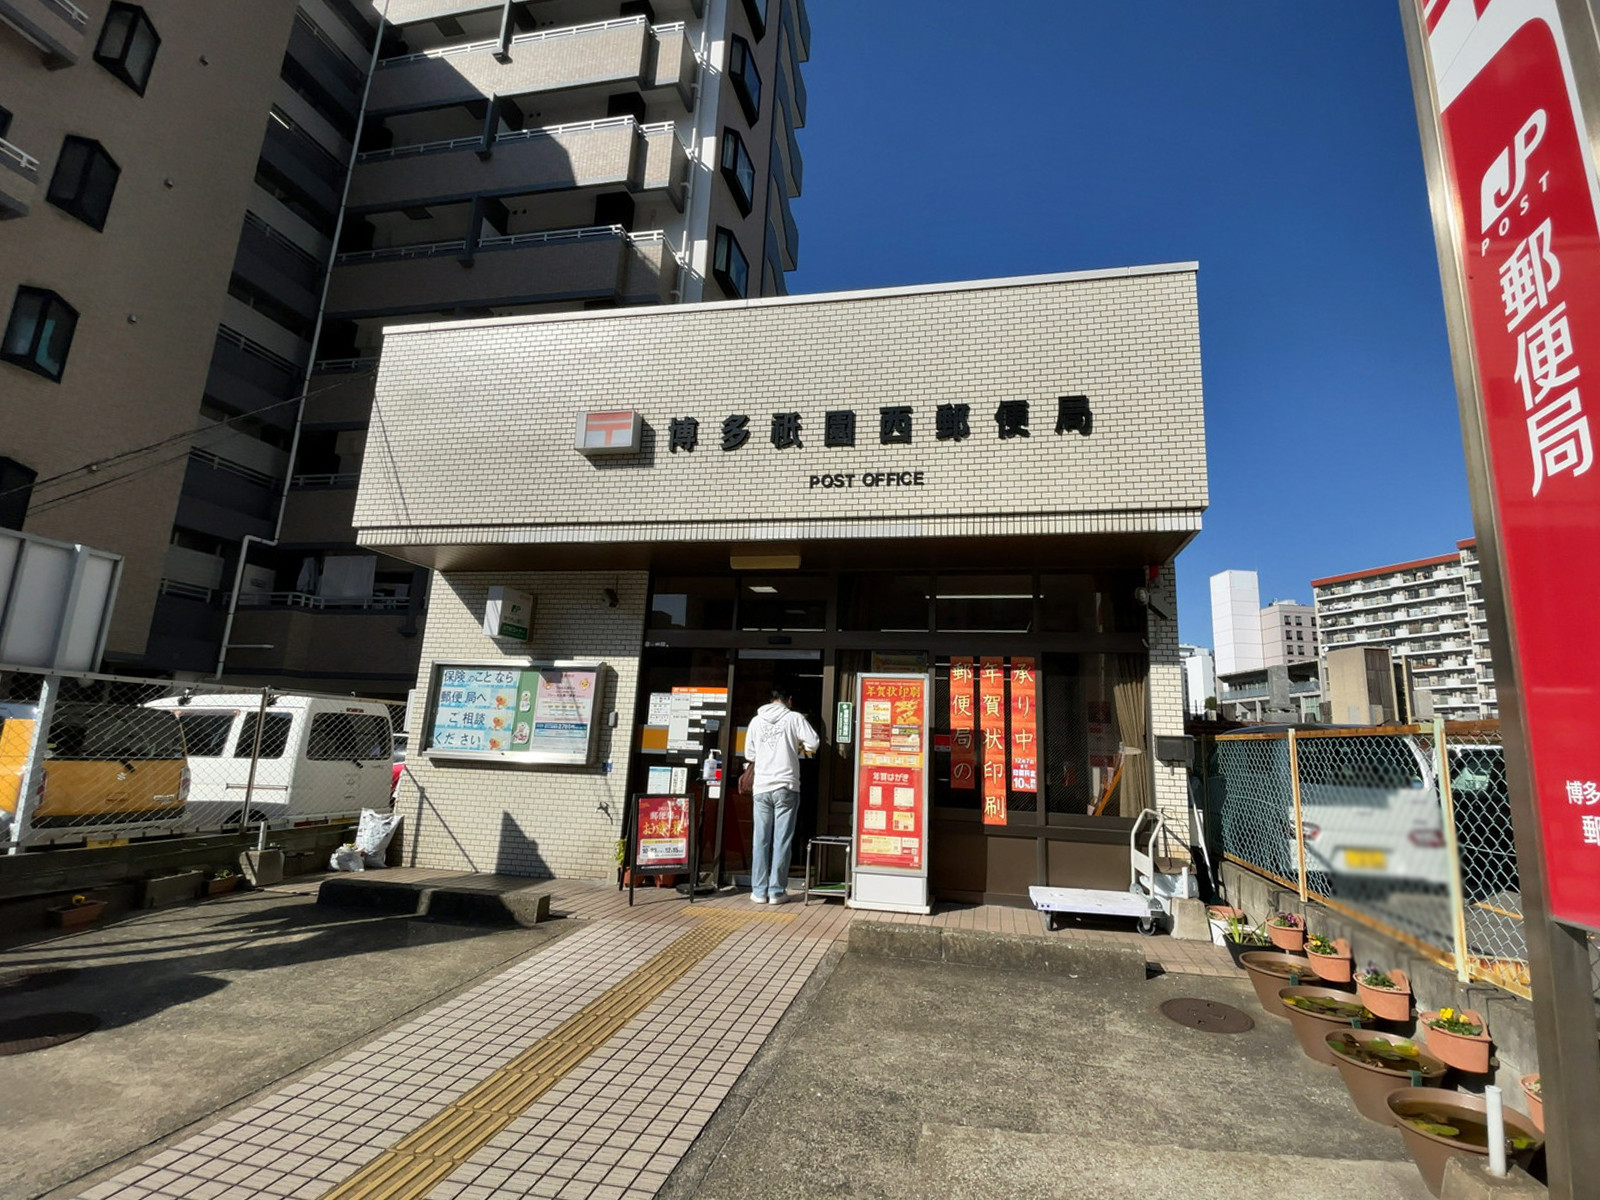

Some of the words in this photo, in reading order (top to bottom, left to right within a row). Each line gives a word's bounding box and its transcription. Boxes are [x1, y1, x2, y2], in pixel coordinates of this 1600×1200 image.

[1481, 170, 1550, 257] POST
[1499, 217, 1594, 498] 郵便局
[809, 473, 855, 489] POST
[862, 471, 925, 487] OFFICE
[440, 690, 487, 704] 郵便局へ
[865, 685, 921, 698] 年賀状印刷
[1012, 662, 1035, 752] 承り中
[435, 732, 481, 746] ください
[448, 712, 486, 726] ご相談
[952, 662, 973, 781] 郵便局の
[981, 661, 1006, 820] 年賀状印刷
